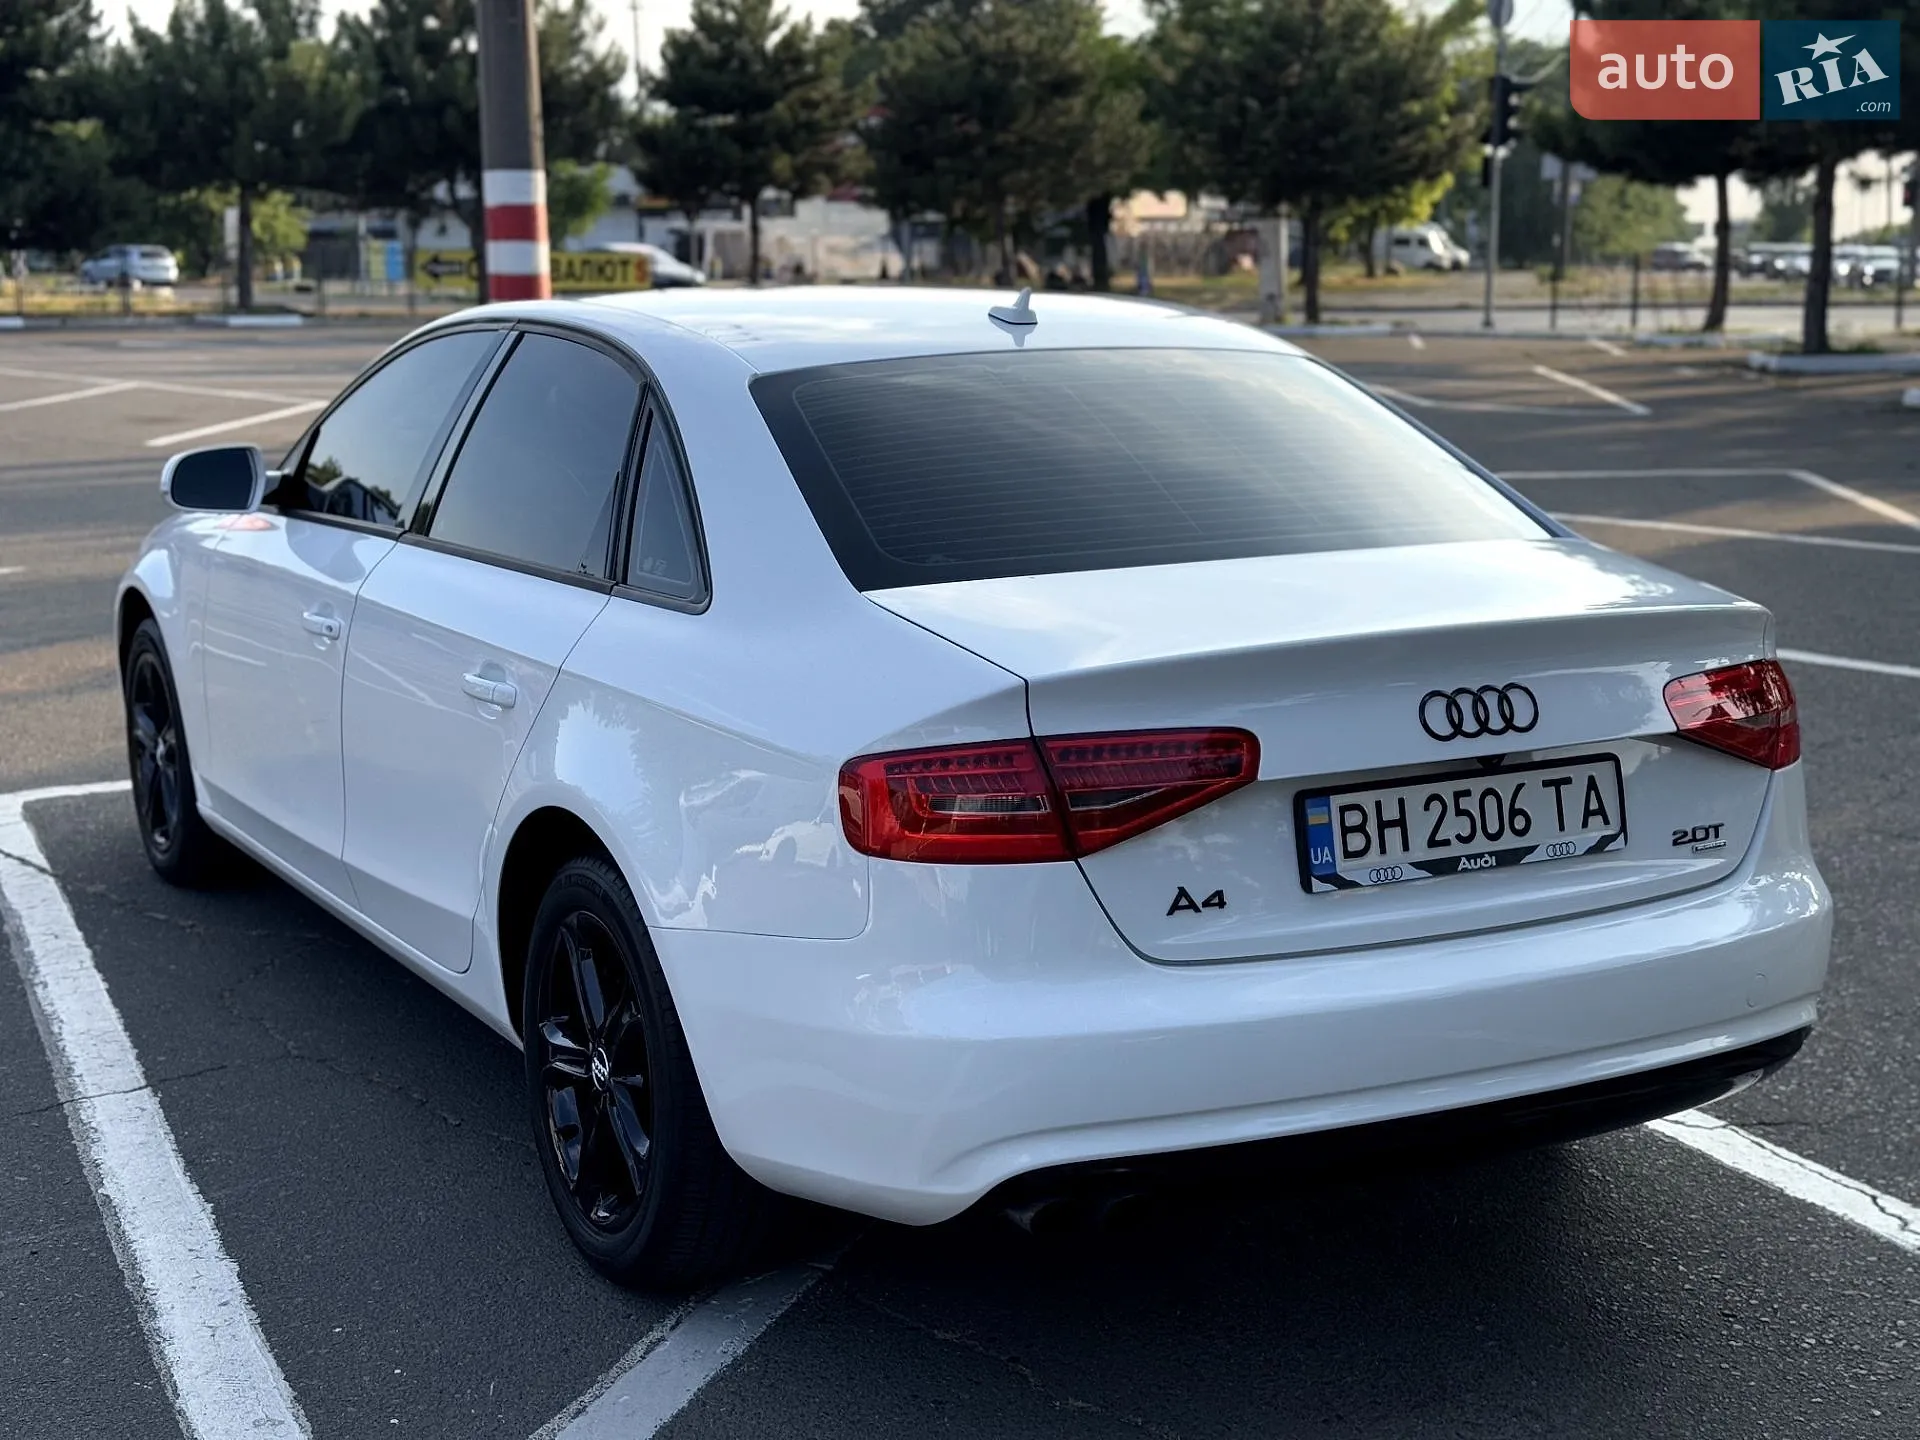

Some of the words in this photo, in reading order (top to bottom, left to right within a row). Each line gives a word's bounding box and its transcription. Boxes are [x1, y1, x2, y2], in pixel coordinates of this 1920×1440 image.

[1339, 797, 1409, 859] BH
[1423, 783, 1532, 848] 2506
[1542, 775, 1611, 832] TA
[1311, 846, 1332, 864] UA
[1458, 854, 1496, 871] Audi
[1166, 886, 1227, 916] A4
